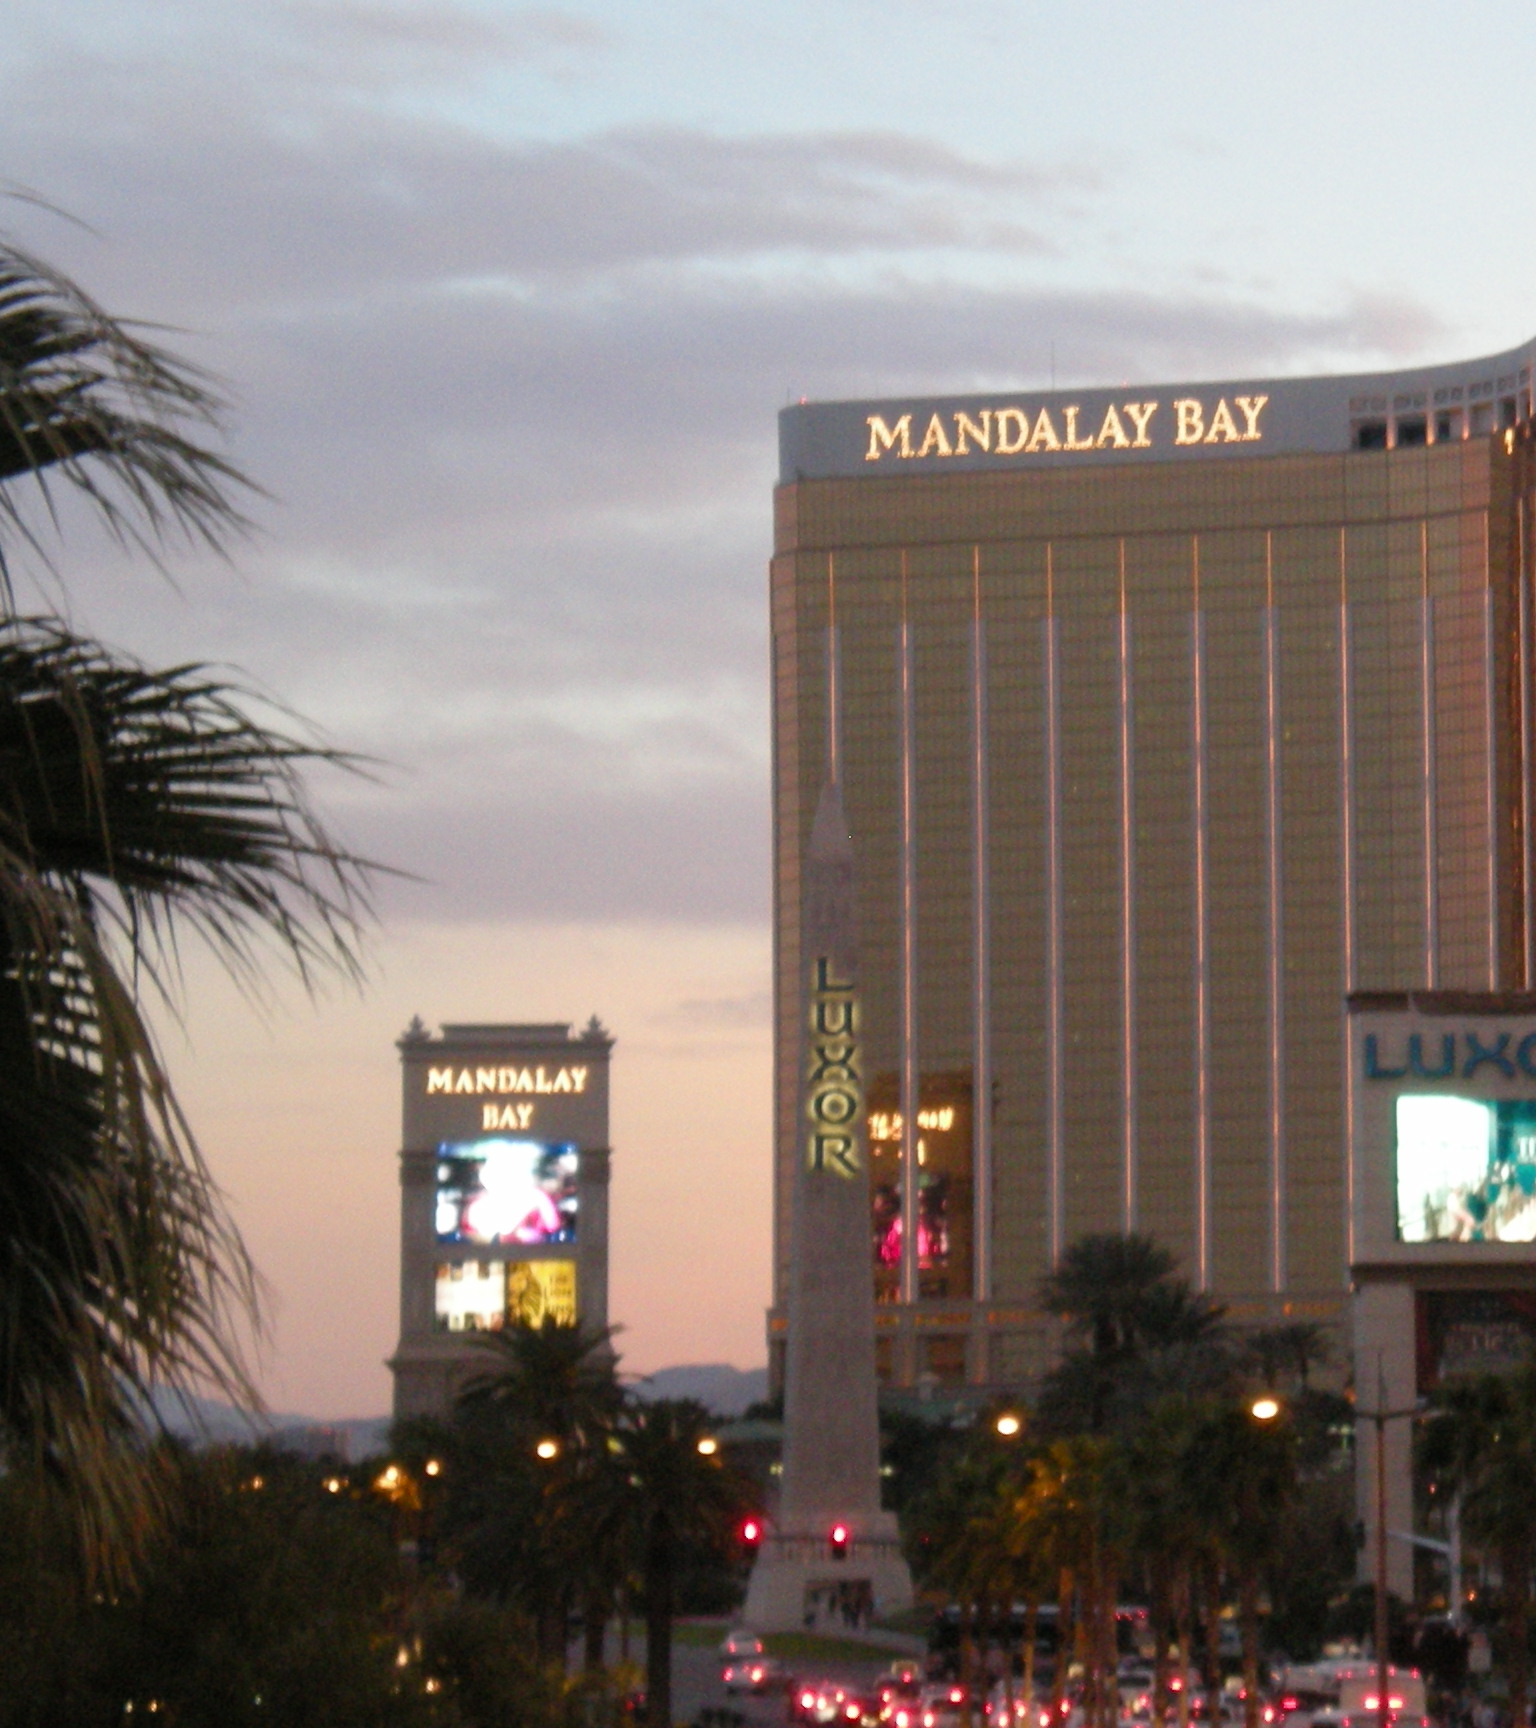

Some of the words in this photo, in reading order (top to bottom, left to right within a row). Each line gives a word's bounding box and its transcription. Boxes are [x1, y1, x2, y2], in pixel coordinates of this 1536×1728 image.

[866, 402, 1157, 460] MANDALAY
[1174, 397, 1268, 445] BAY
[427, 1066, 587, 1094] MANDALAY
[811, 956, 856, 1176] LUXOR
[482, 1103, 533, 1130] BAY
